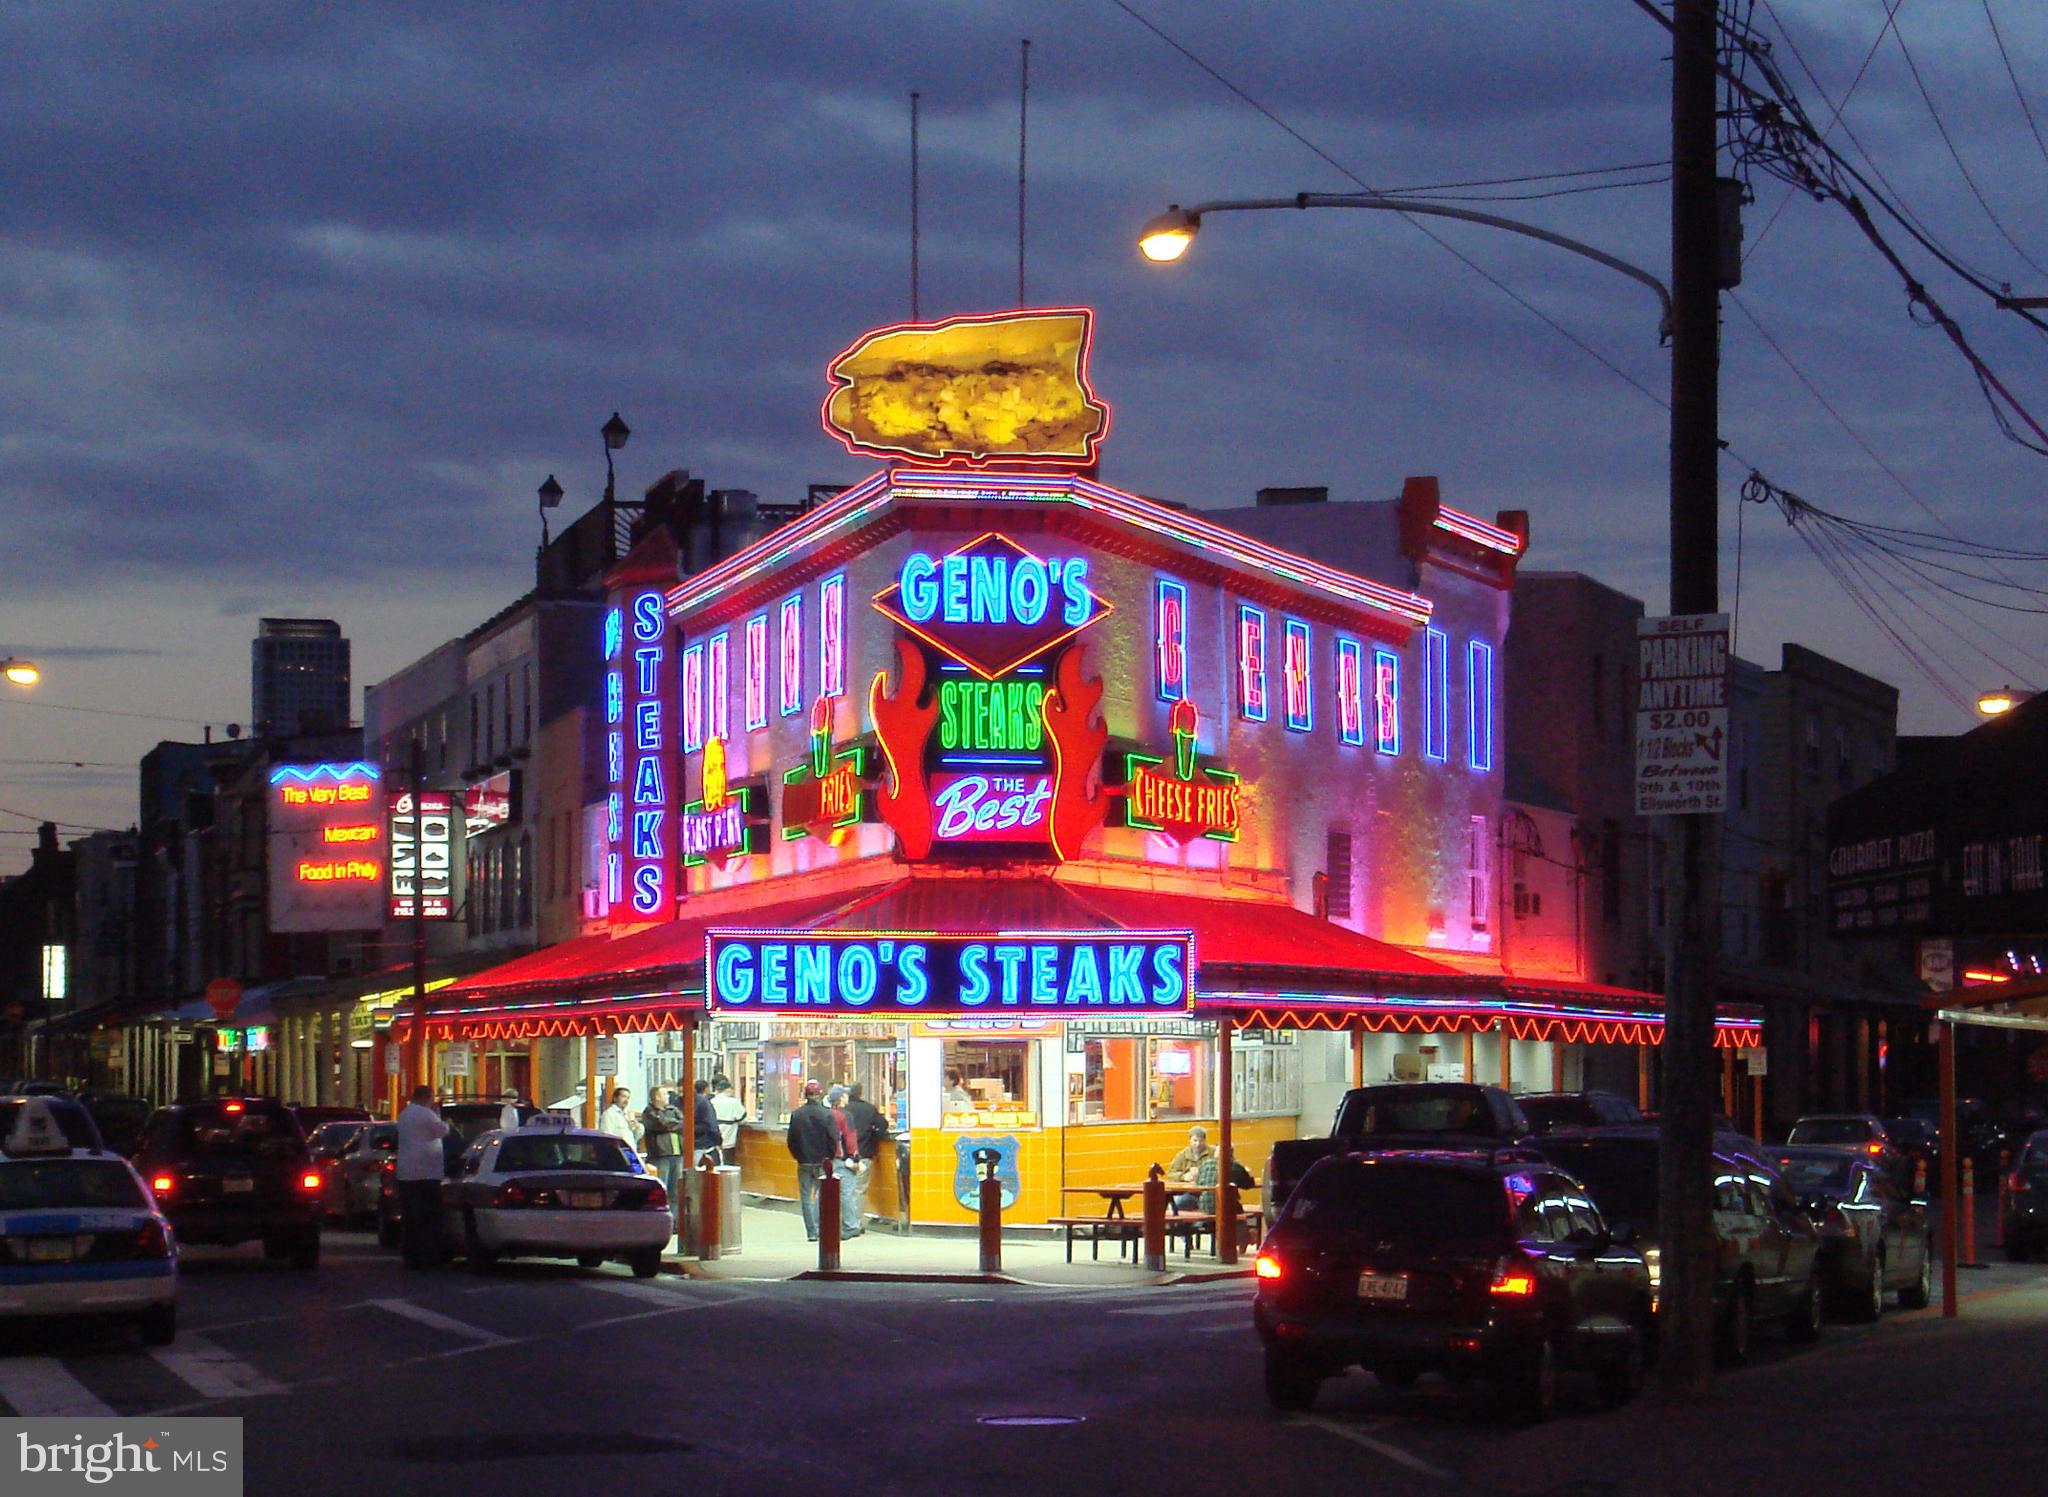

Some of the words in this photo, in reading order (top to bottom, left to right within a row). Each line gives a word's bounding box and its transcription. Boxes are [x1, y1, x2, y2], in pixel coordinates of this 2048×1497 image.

[900, 553, 1093, 626] GENO'S
[1657, 618, 1705, 632] SELF
[1639, 634, 1726, 679] PARKING
[1639, 677, 1725, 709] ANYTIME
[940, 682, 1043, 751] STEAKS
[1649, 711, 1710, 730] $2.00
[633, 592, 664, 915] STEAKS
[1662, 736, 1695, 760] Blocks
[993, 777, 1025, 792] THE
[1638, 782, 1663, 794] 9th
[1669, 781, 1681, 793] &
[1687, 780, 1721, 792] 10th
[1641, 764, 1719, 779] Between
[282, 787, 307, 804] The
[309, 787, 337, 804] Very
[339, 784, 370, 801] Best
[821, 761, 854, 819] FRIES
[1131, 767, 1192, 824] CHEESE
[1197, 784, 1240, 832] FRIES
[935, 775, 1052, 839] Best
[324, 825, 377, 843] Mexican
[1829, 838, 1893, 879] GOURMET
[1898, 829, 1936, 865] PIZZA
[299, 863, 332, 881] Food
[346, 862, 378, 881] Philly
[716, 940, 929, 1006] GENO'S
[959, 943, 1184, 1007] STEAKS
